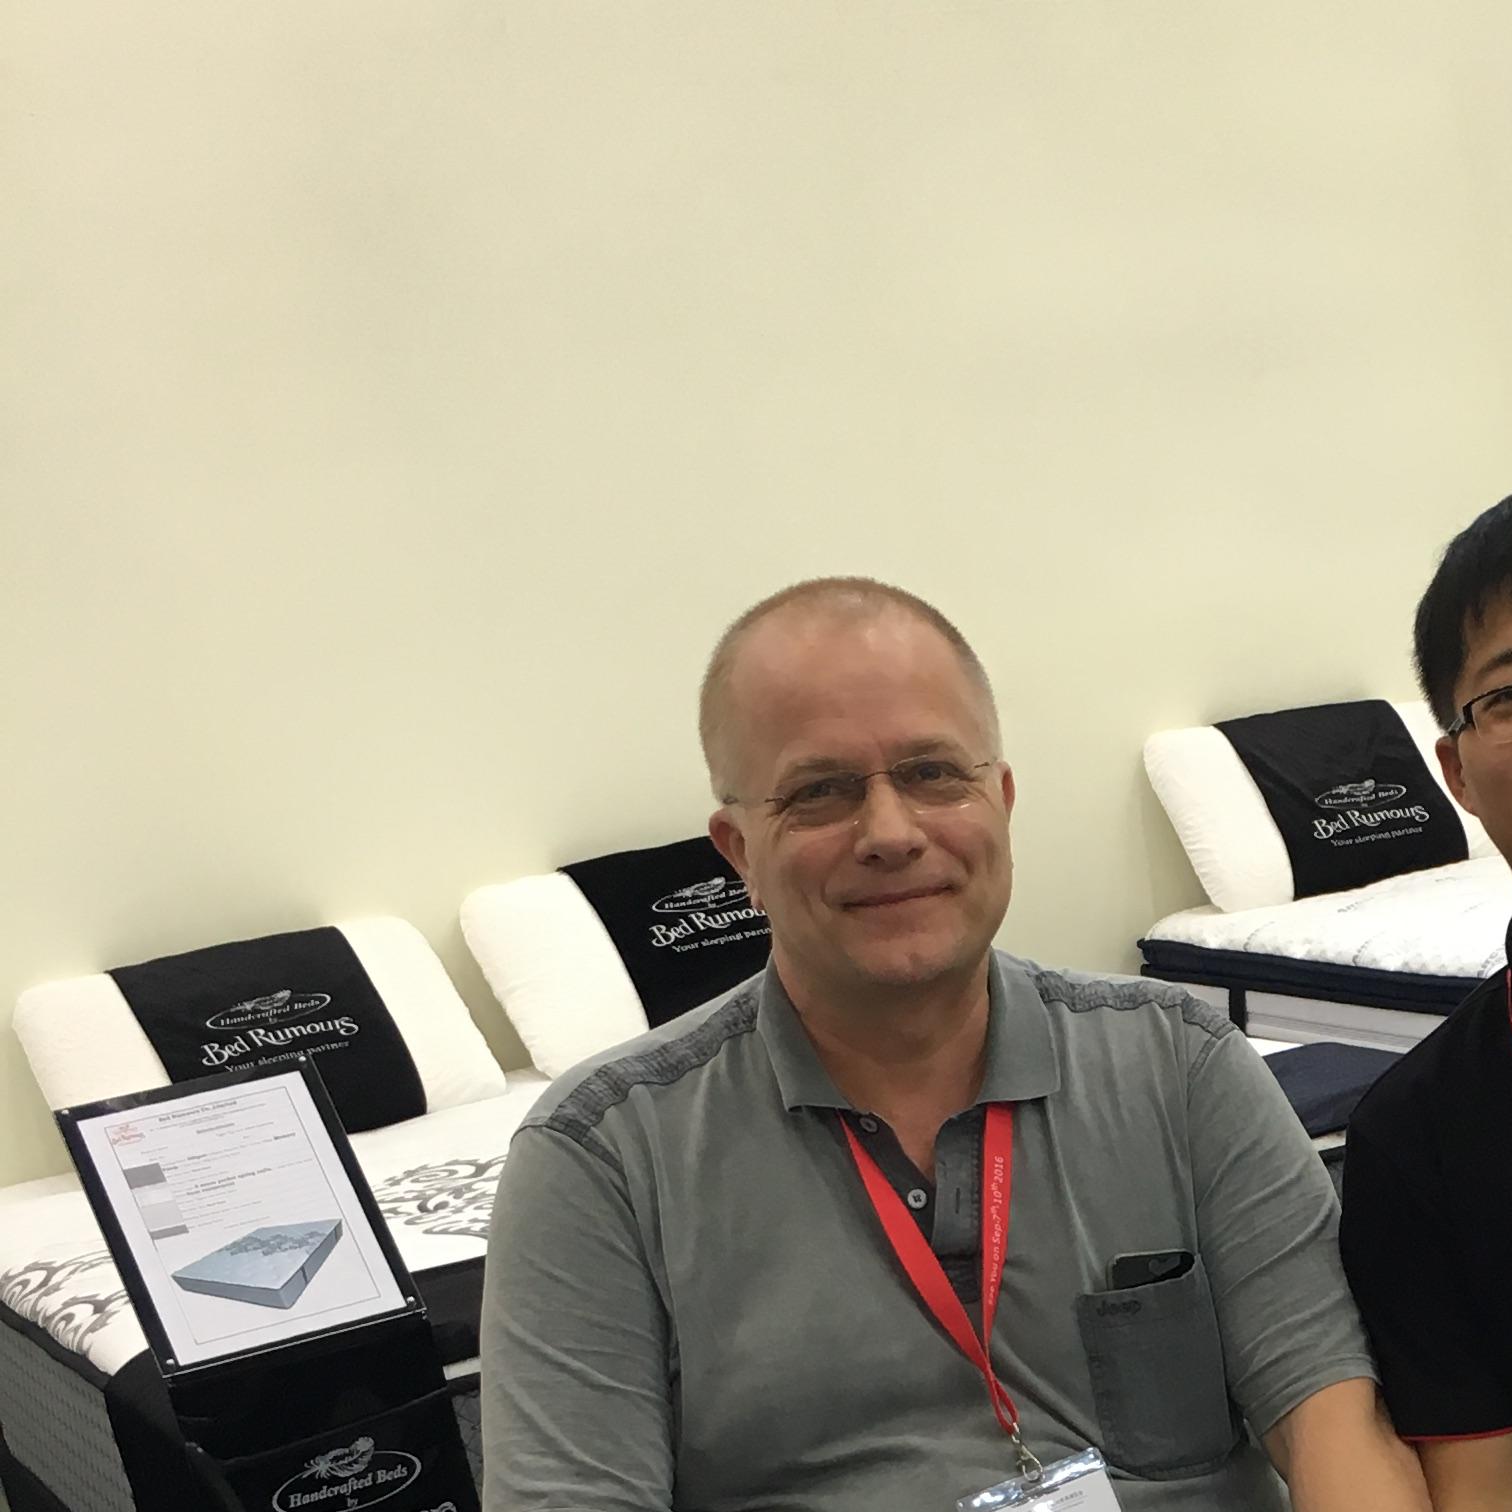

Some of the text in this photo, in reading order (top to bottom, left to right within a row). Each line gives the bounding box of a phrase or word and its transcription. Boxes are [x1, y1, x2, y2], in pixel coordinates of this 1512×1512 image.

[1312, 805, 1430, 839] Bed Rumours
[649, 918, 696, 947] Bed
[672, 942, 700, 953] Your
[701, 932, 744, 947] sleeping
[201, 1016, 360, 1066] Bed Rumours
[994, 1156, 1004, 1183] 2016
[288, 1464, 408, 1509] Handcrafted Beds
